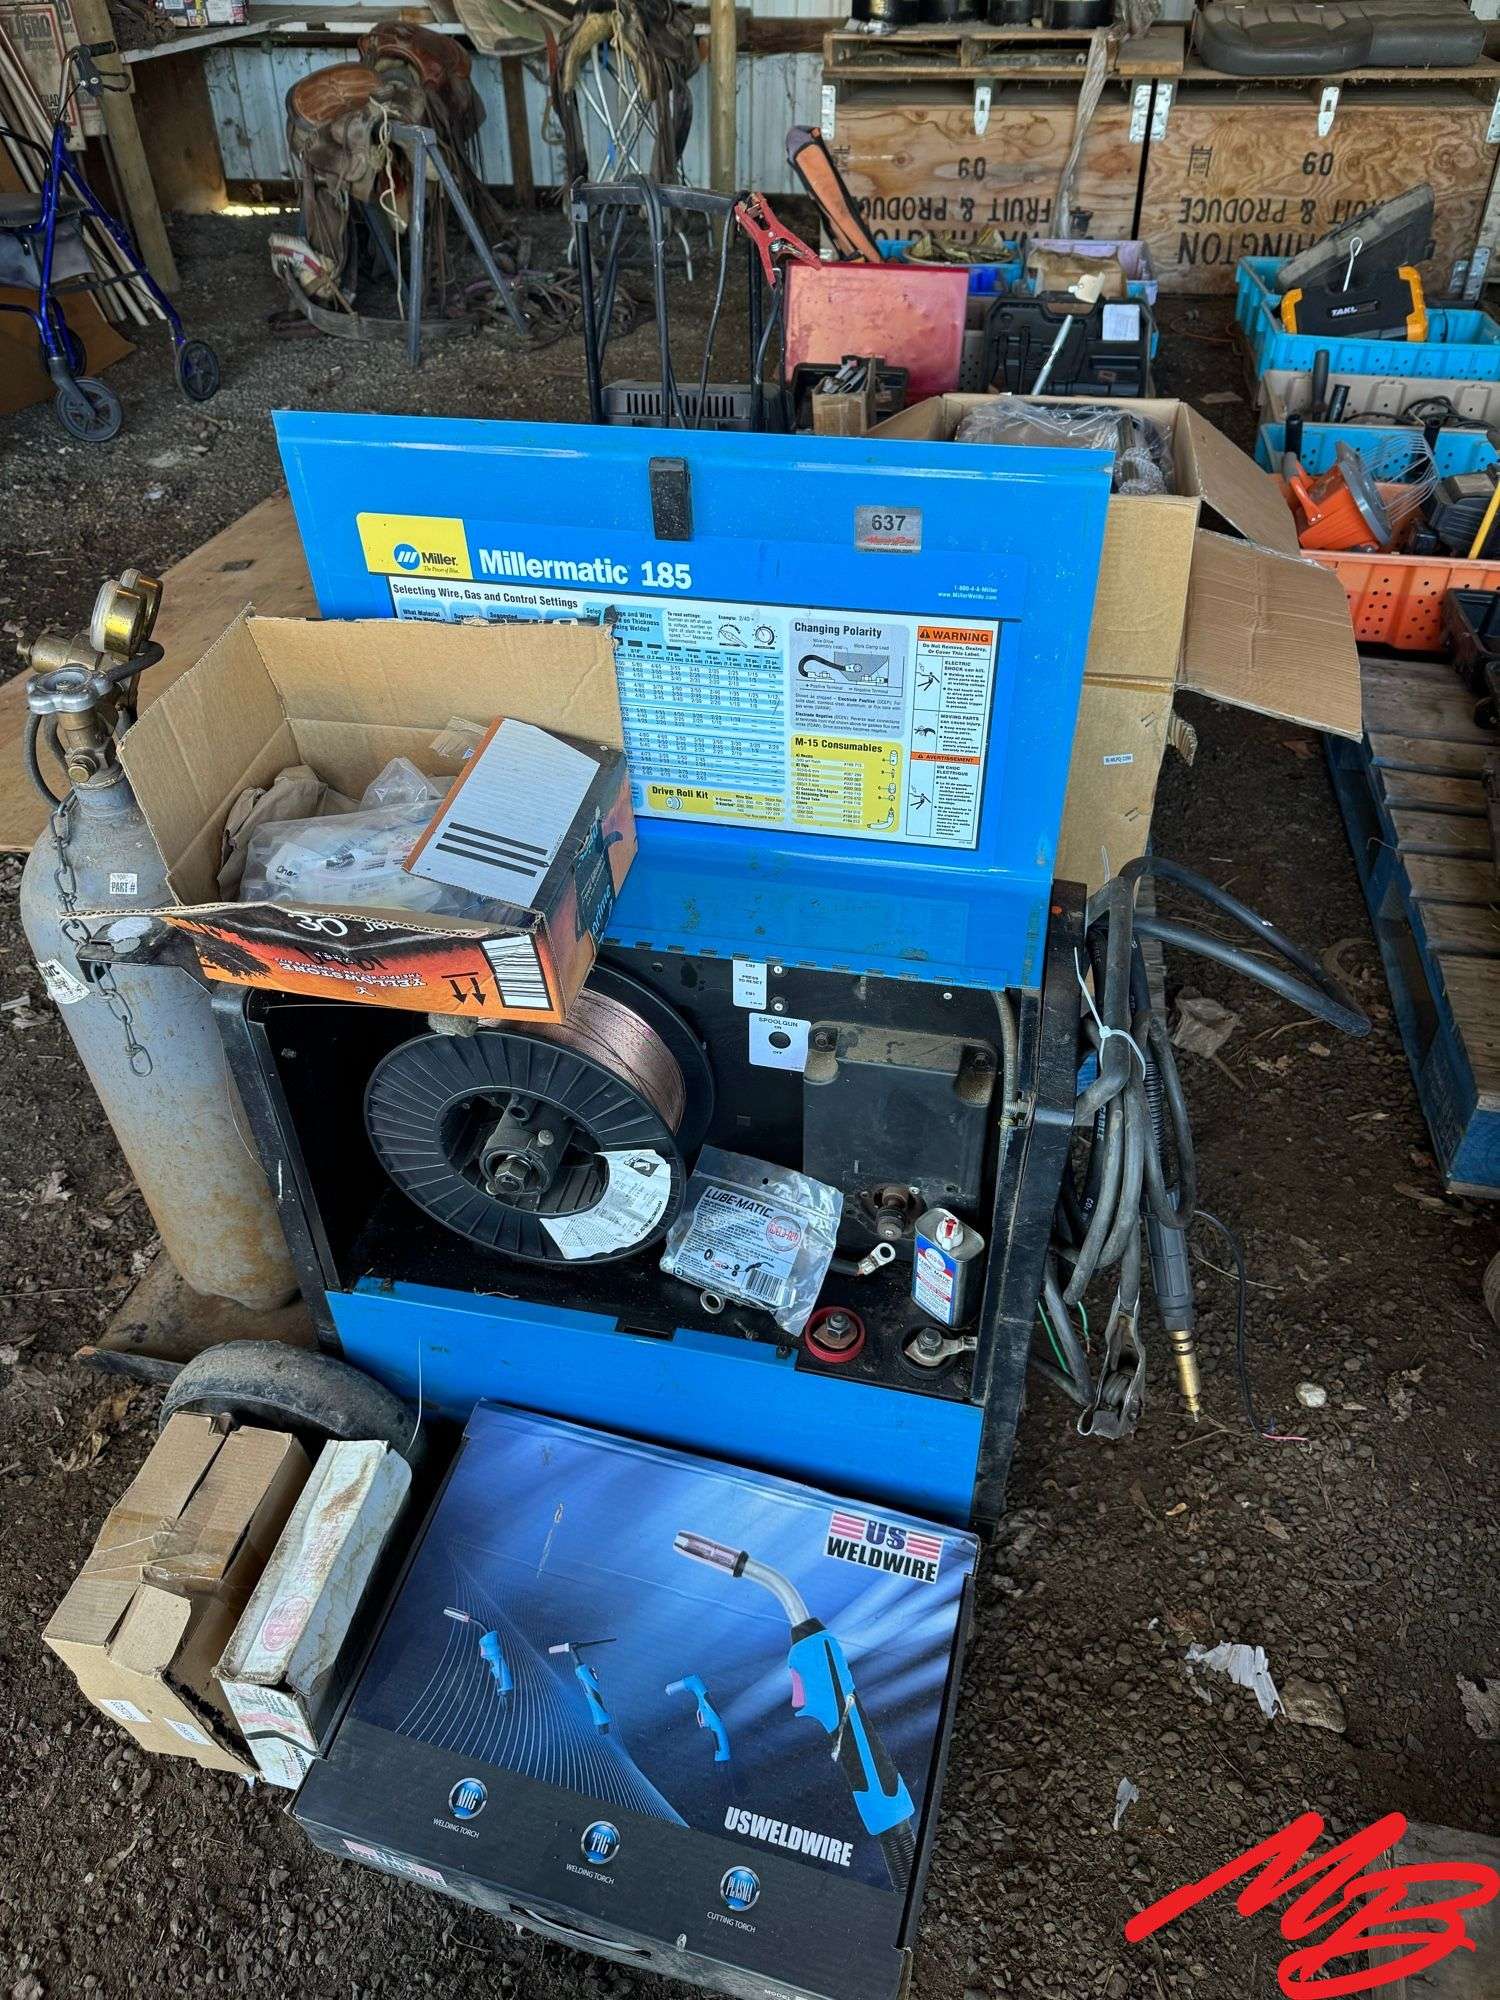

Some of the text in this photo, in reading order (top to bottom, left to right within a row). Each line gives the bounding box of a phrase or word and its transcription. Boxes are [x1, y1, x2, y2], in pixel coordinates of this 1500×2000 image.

[960, 198, 975, 221] &
[988, 198, 1051, 222] FRUIT
[1178, 197, 1288, 224] PRODUCE
[1301, 200, 1317, 224] &
[1178, 231, 1316, 265] HINGTON
[871, 514, 906, 531] 637
[421, 552, 457, 566] Miller
[479, 549, 692, 590] Millermatic 185
[393, 584, 578, 609] Selecting Wire, Gas and Control Settings
[794, 622, 882, 639] Changing Polarity
[933, 630, 989, 643] WARNING
[795, 737, 883, 753] M-15 Consumables
[926, 754, 974, 762] AVERTISSEMENT
[652, 786, 709, 799] Drive Roll Kit
[111, 881, 136, 893] PART #
[278, 961, 428, 987] YELLOWSTONE
[704, 1188, 775, 1219] LUBE-MATIC
[865, 1519, 908, 1550] US
[826, 1536, 938, 1584] WELDWIRE
[456, 1787, 479, 1811] MIG
[432, 1817, 480, 1839] WELDING TORCH
[724, 1805, 854, 1868] USWELDWIRE
[589, 1831, 612, 1855] TIG
[565, 1863, 616, 1885] WELDING TORCH
[726, 1876, 754, 1903] PLASMA
[706, 1911, 757, 1933] CUTTING TORCH
